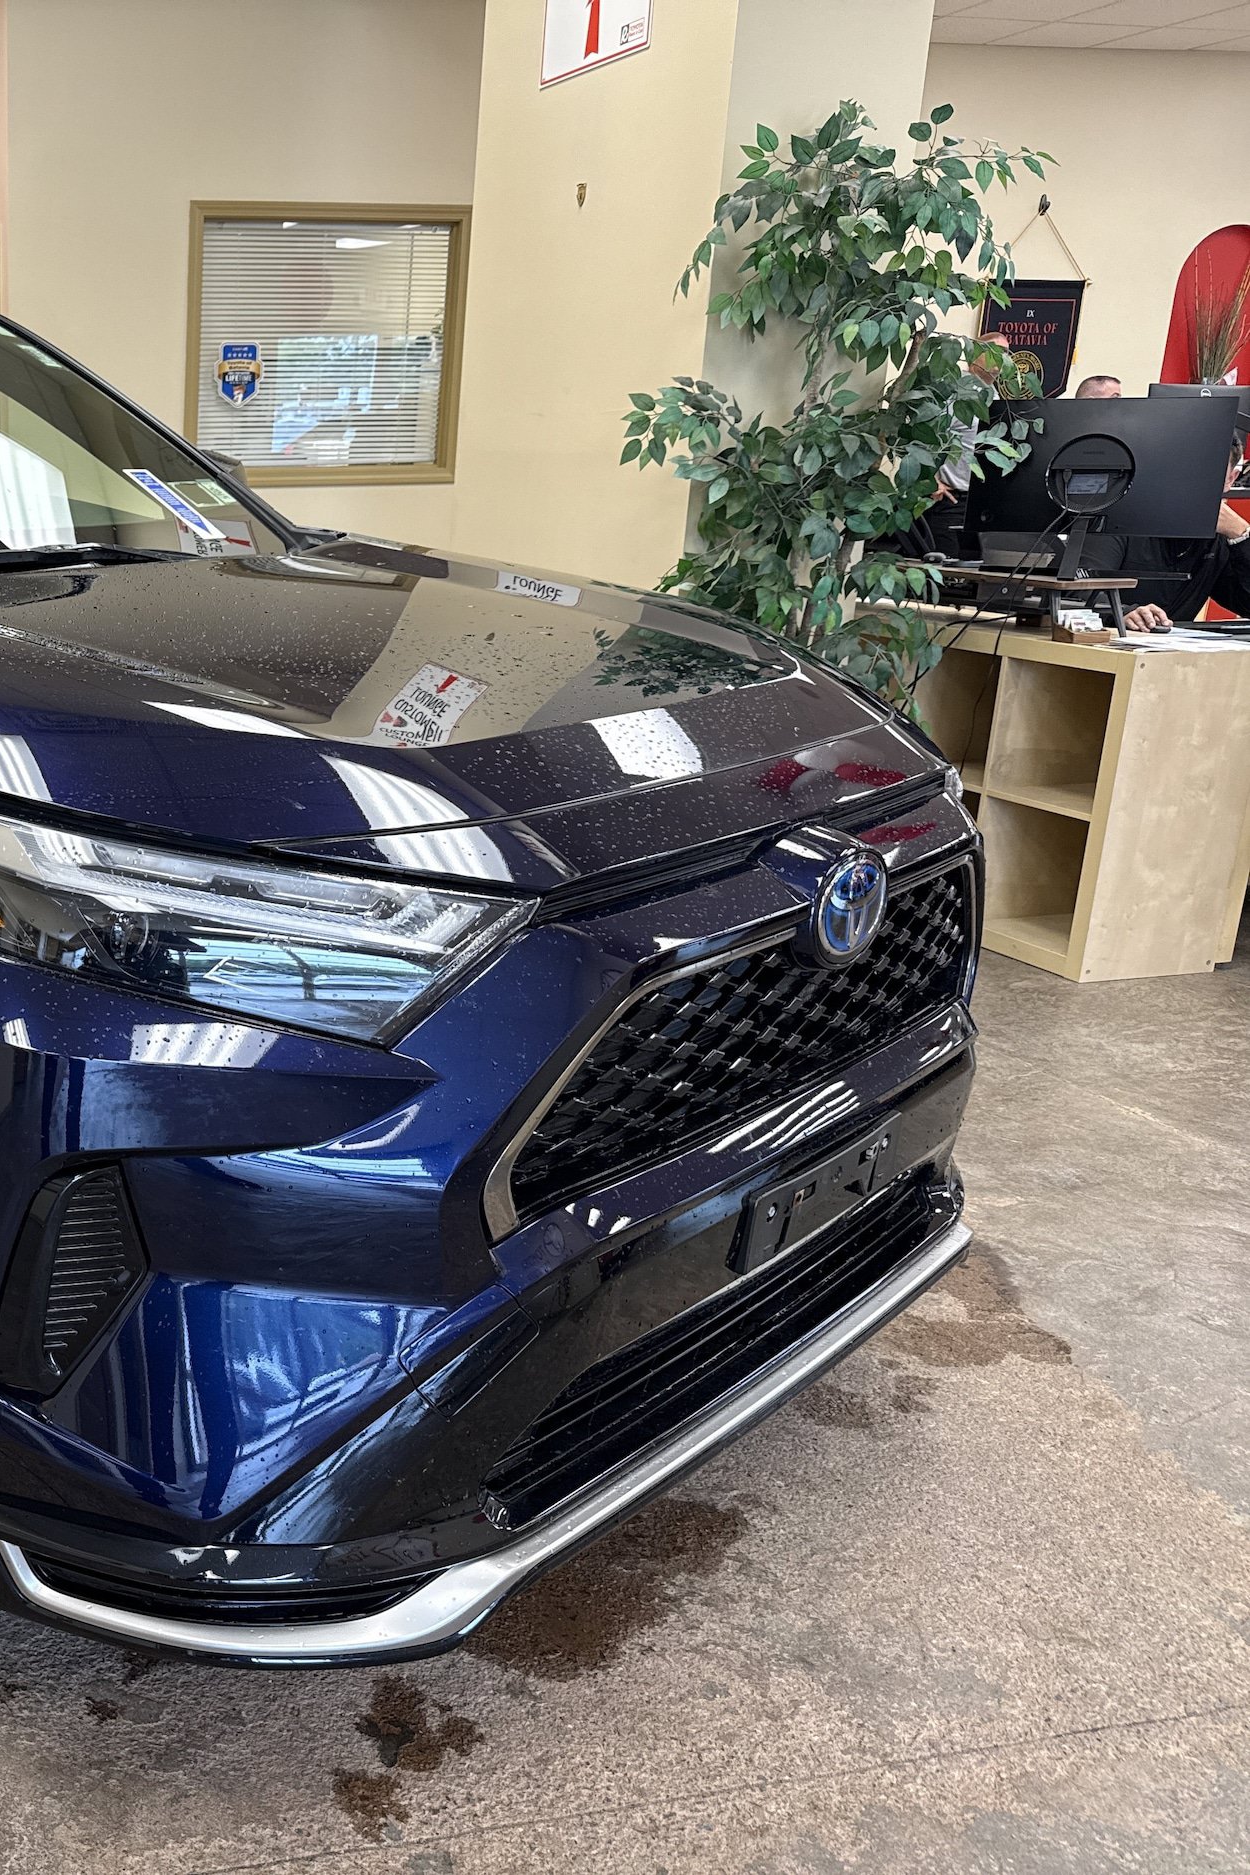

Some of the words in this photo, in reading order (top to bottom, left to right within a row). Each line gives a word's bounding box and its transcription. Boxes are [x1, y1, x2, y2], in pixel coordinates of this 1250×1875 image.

[1026, 309, 1035, 318] IX
[998, 321, 1039, 334] TOYOTA
[1043, 322, 1058, 334] OF
